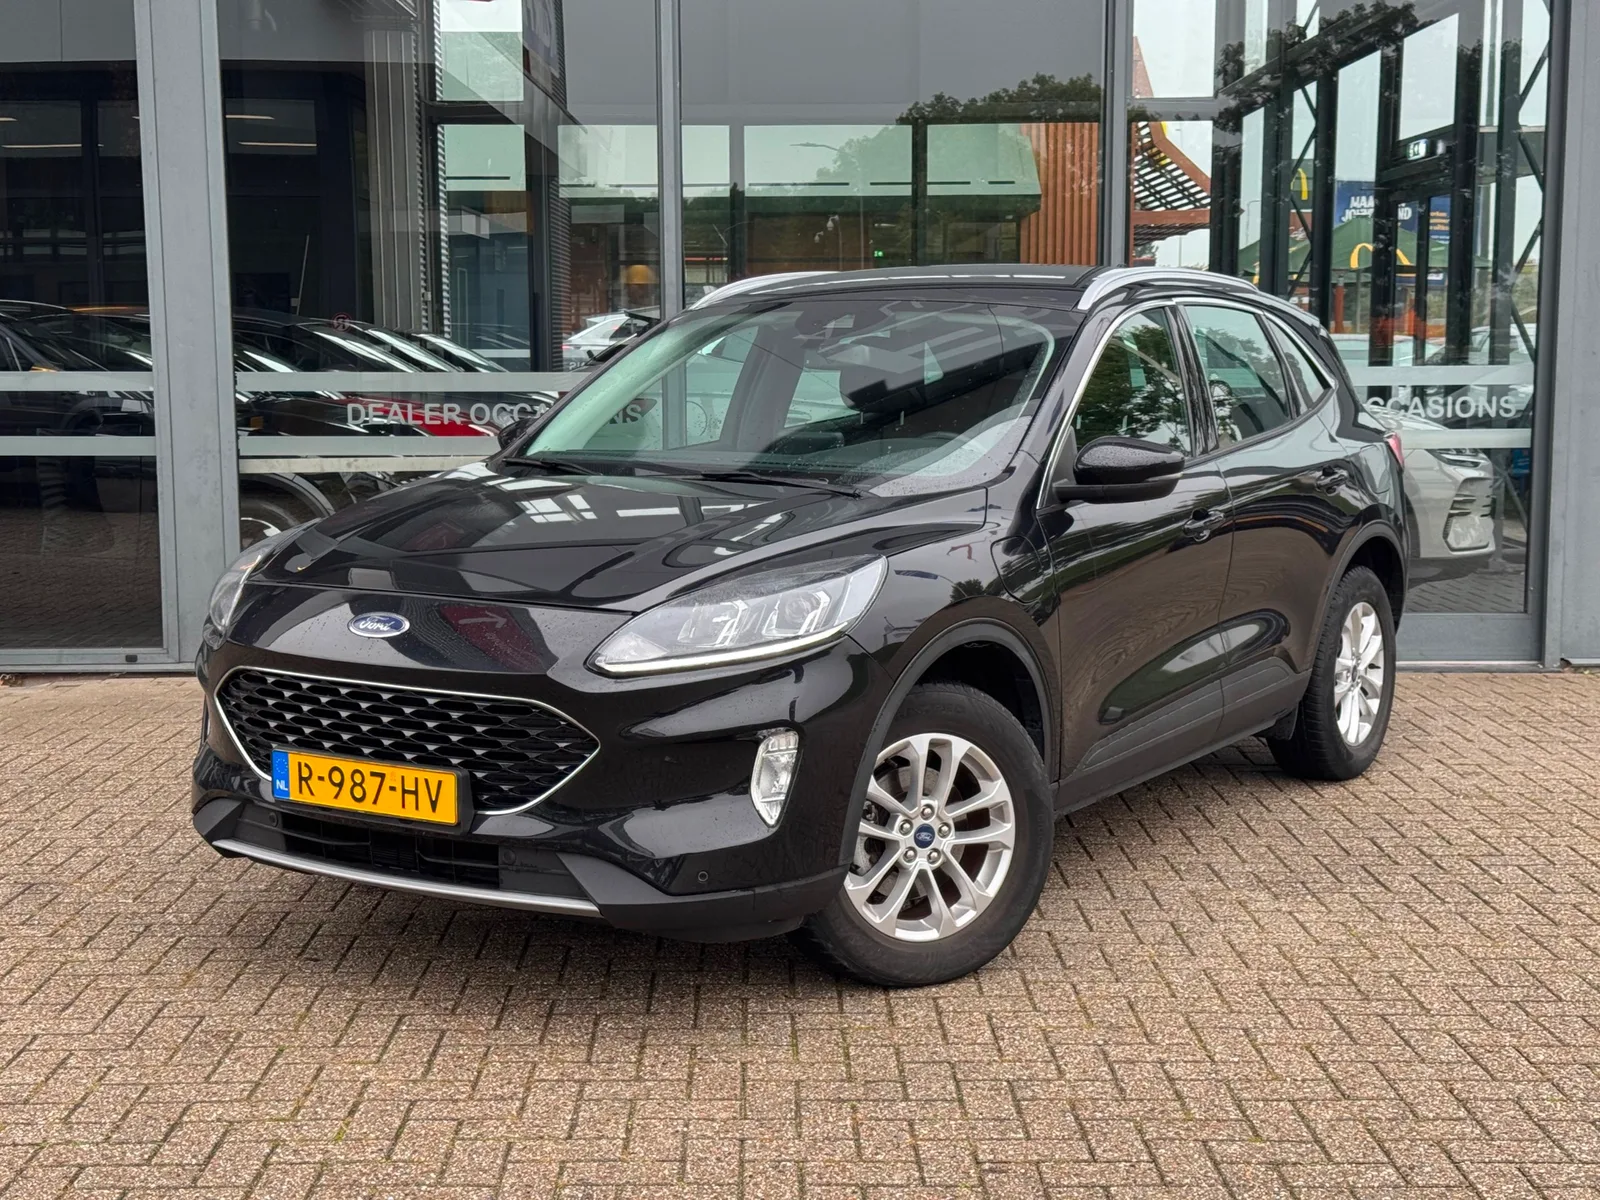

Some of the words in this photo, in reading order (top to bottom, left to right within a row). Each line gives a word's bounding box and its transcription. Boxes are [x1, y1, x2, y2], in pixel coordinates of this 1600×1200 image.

[347, 402, 462, 425] DEALER
[1366, 396, 1517, 418] CCASIONS
[359, 615, 396, 631] Ford
[276, 779, 289, 791] NL
[297, 760, 443, 813] R-987-HV
